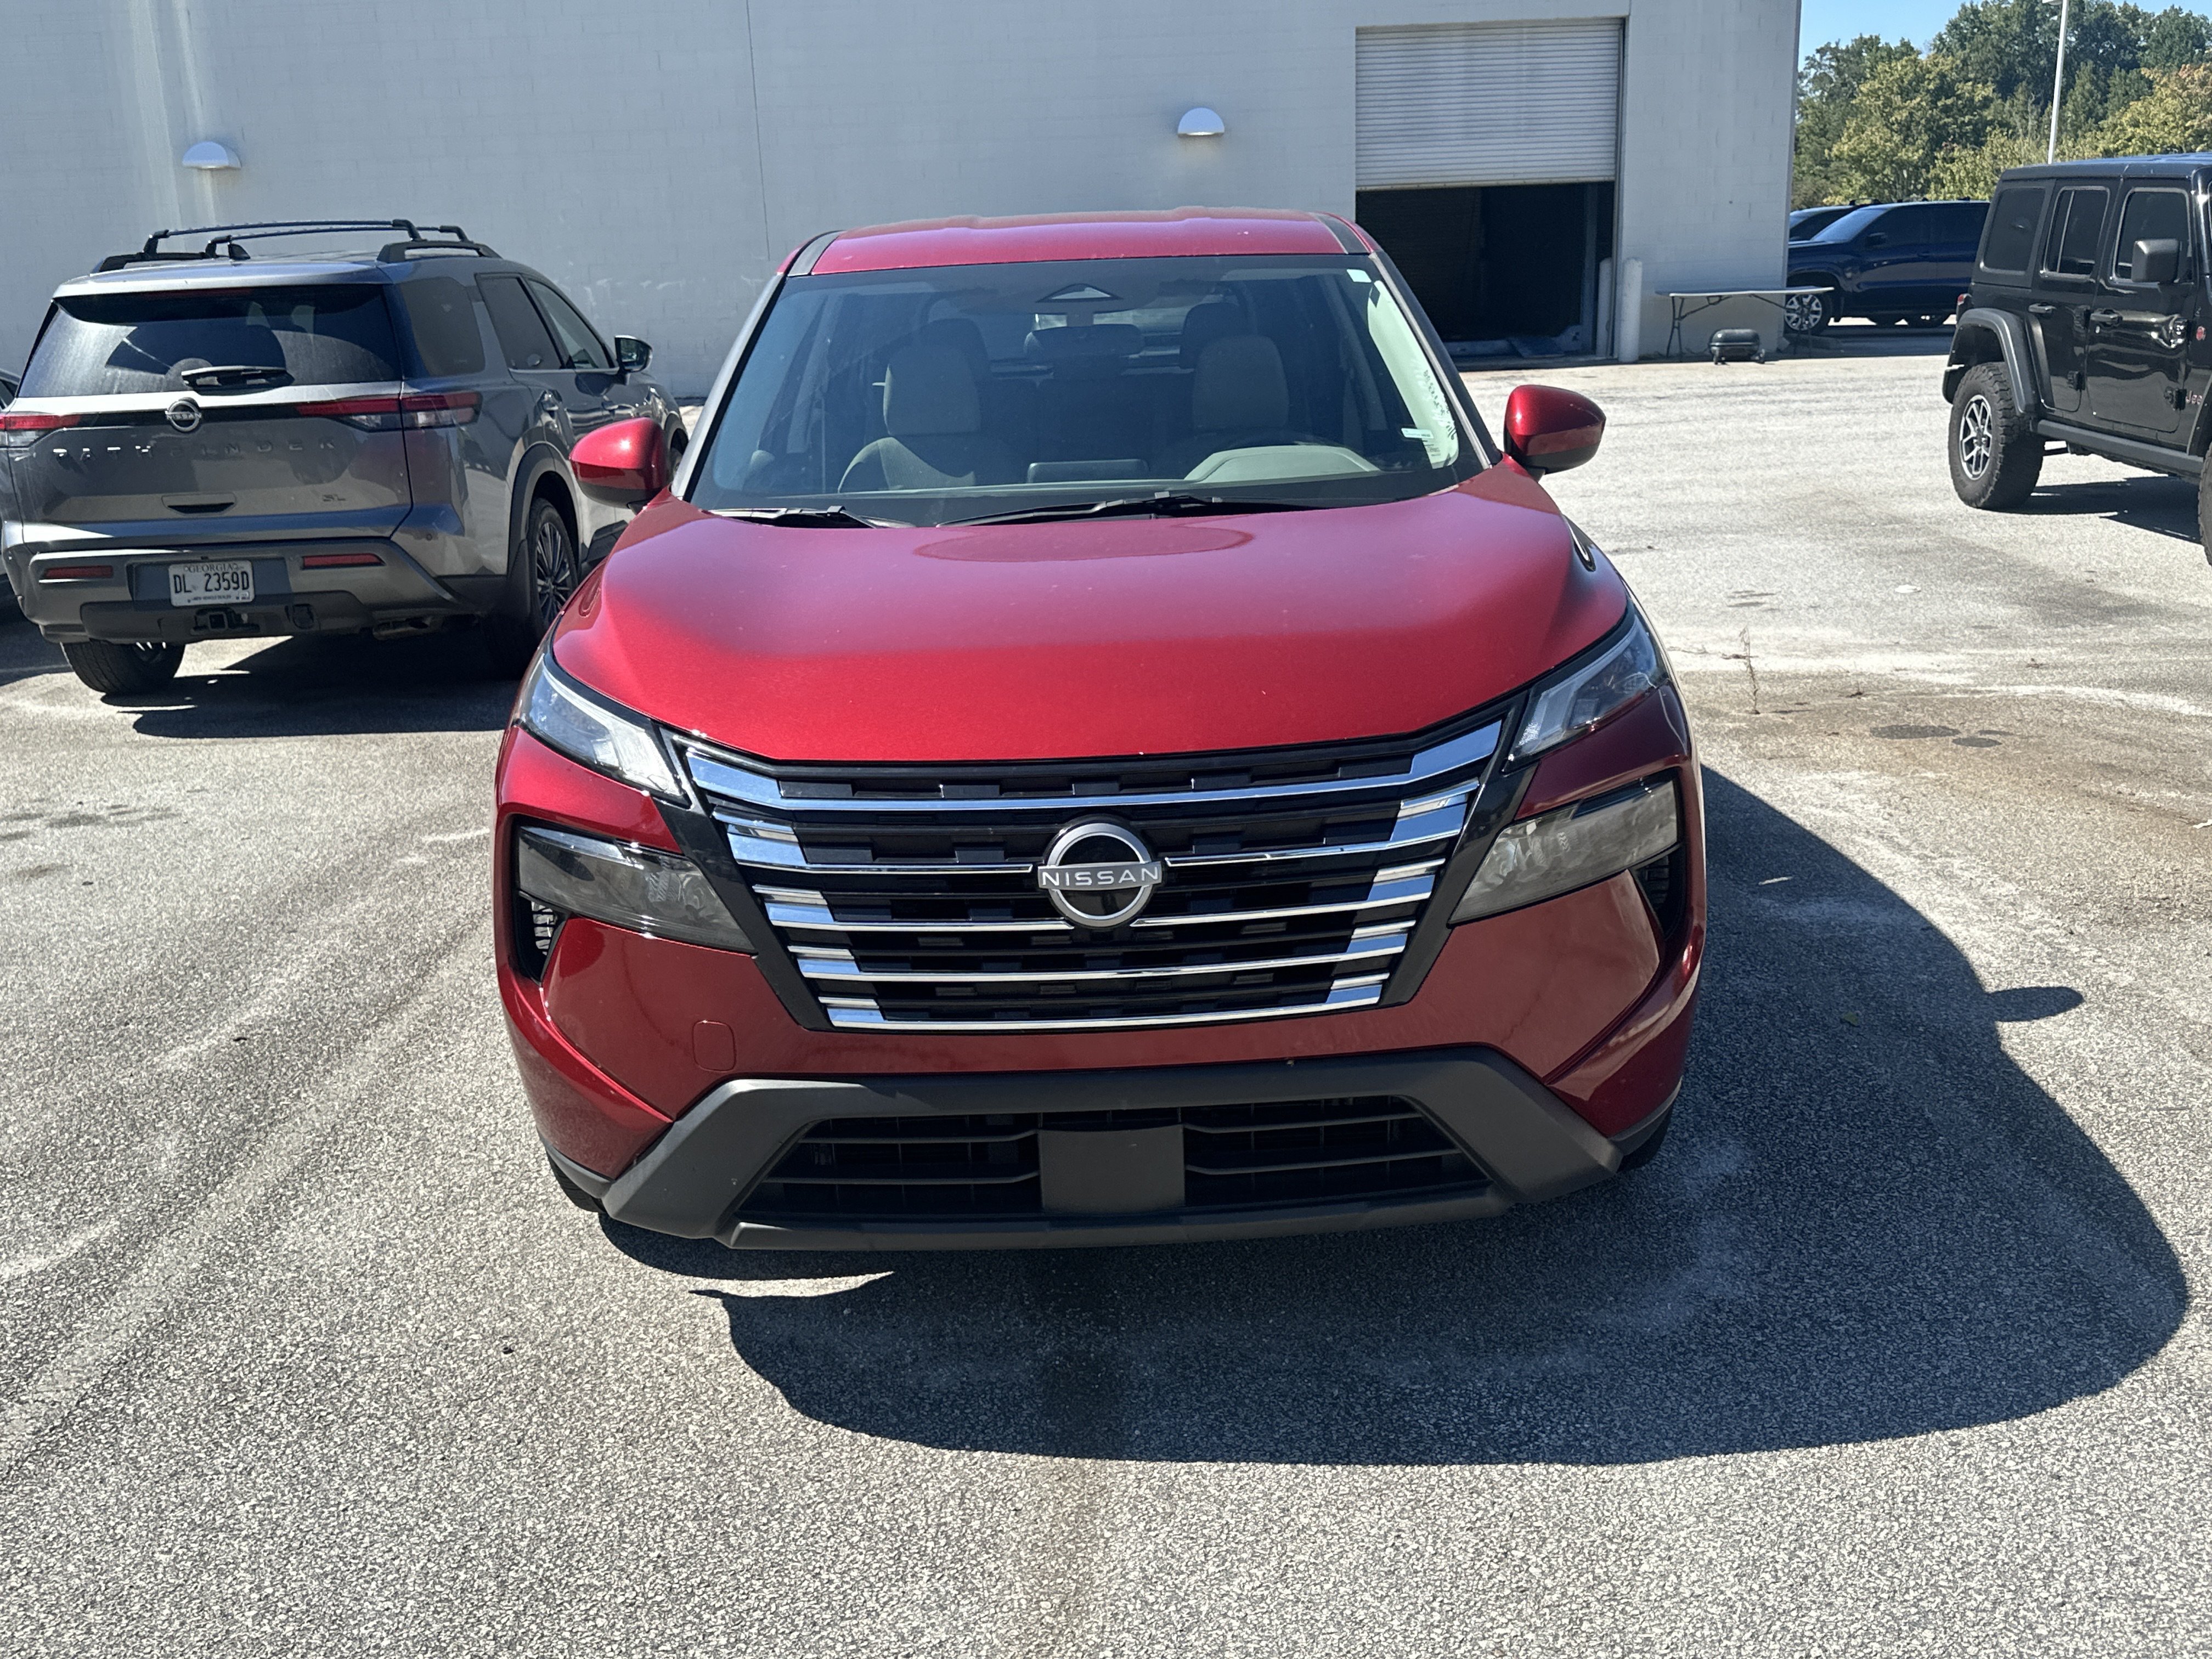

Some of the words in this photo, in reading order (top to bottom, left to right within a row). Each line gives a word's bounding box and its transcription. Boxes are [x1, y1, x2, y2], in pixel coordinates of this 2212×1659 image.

[2185, 390, 2203, 405] Jee
[189, 563, 233, 573] GEORGIA
[173, 574, 191, 594] DL
[205, 572, 250, 592] 2359D
[1042, 867, 1158, 886] NISSAN
